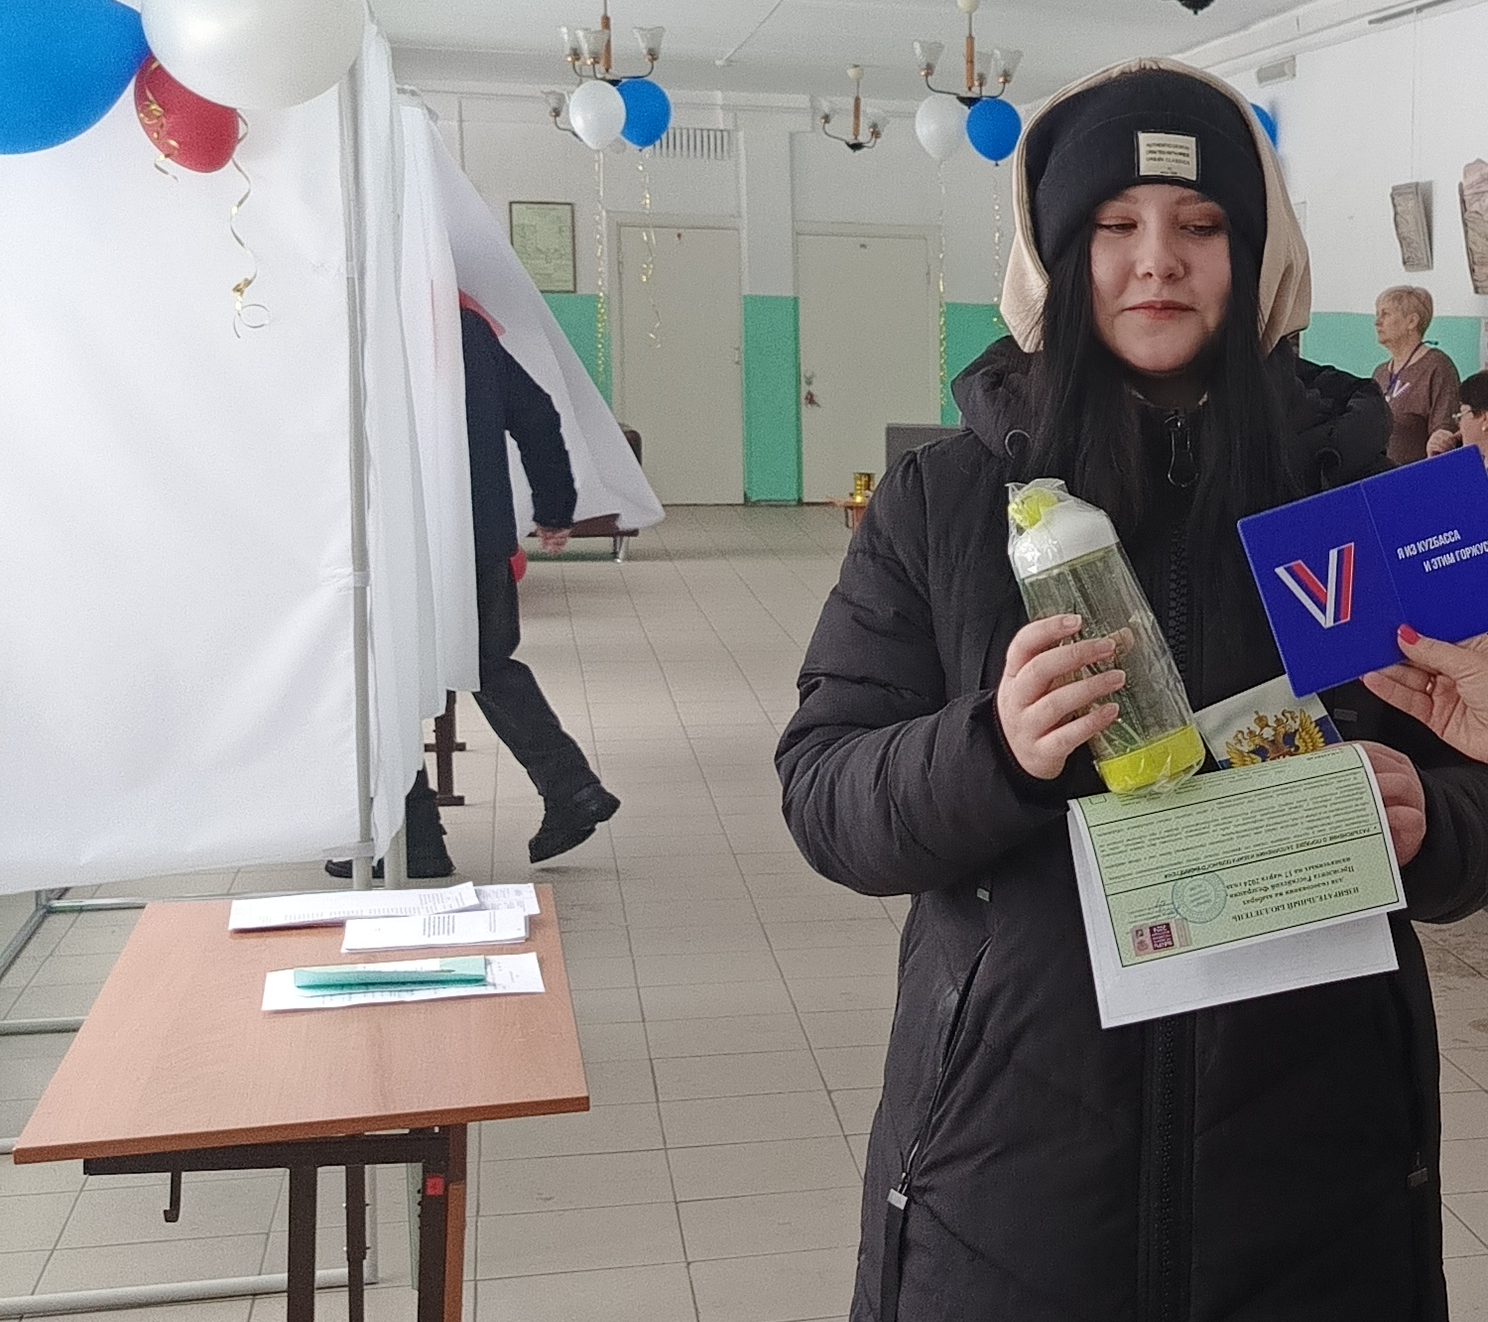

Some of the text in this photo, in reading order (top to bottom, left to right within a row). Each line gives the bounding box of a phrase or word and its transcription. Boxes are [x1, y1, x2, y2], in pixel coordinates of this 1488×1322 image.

[1396, 529, 1461, 560] Я ИЗ КУZБАССА
[1423, 560, 1432, 572] И
[1431, 552, 1455, 570] ЭТИМ
[1261, 872, 1283, 882] марта
[1284, 870, 1293, 878] 17
[1313, 865, 1354, 880] Президента
[1244, 878, 1260, 887] 2024
[1270, 875, 1312, 890] Российской
[1232, 886, 1359, 922] ИЗБИРАТЕЛЬНЫЙ БЮЛЛЕТЕНЬ
[1242, 894, 1273, 907] выборах
